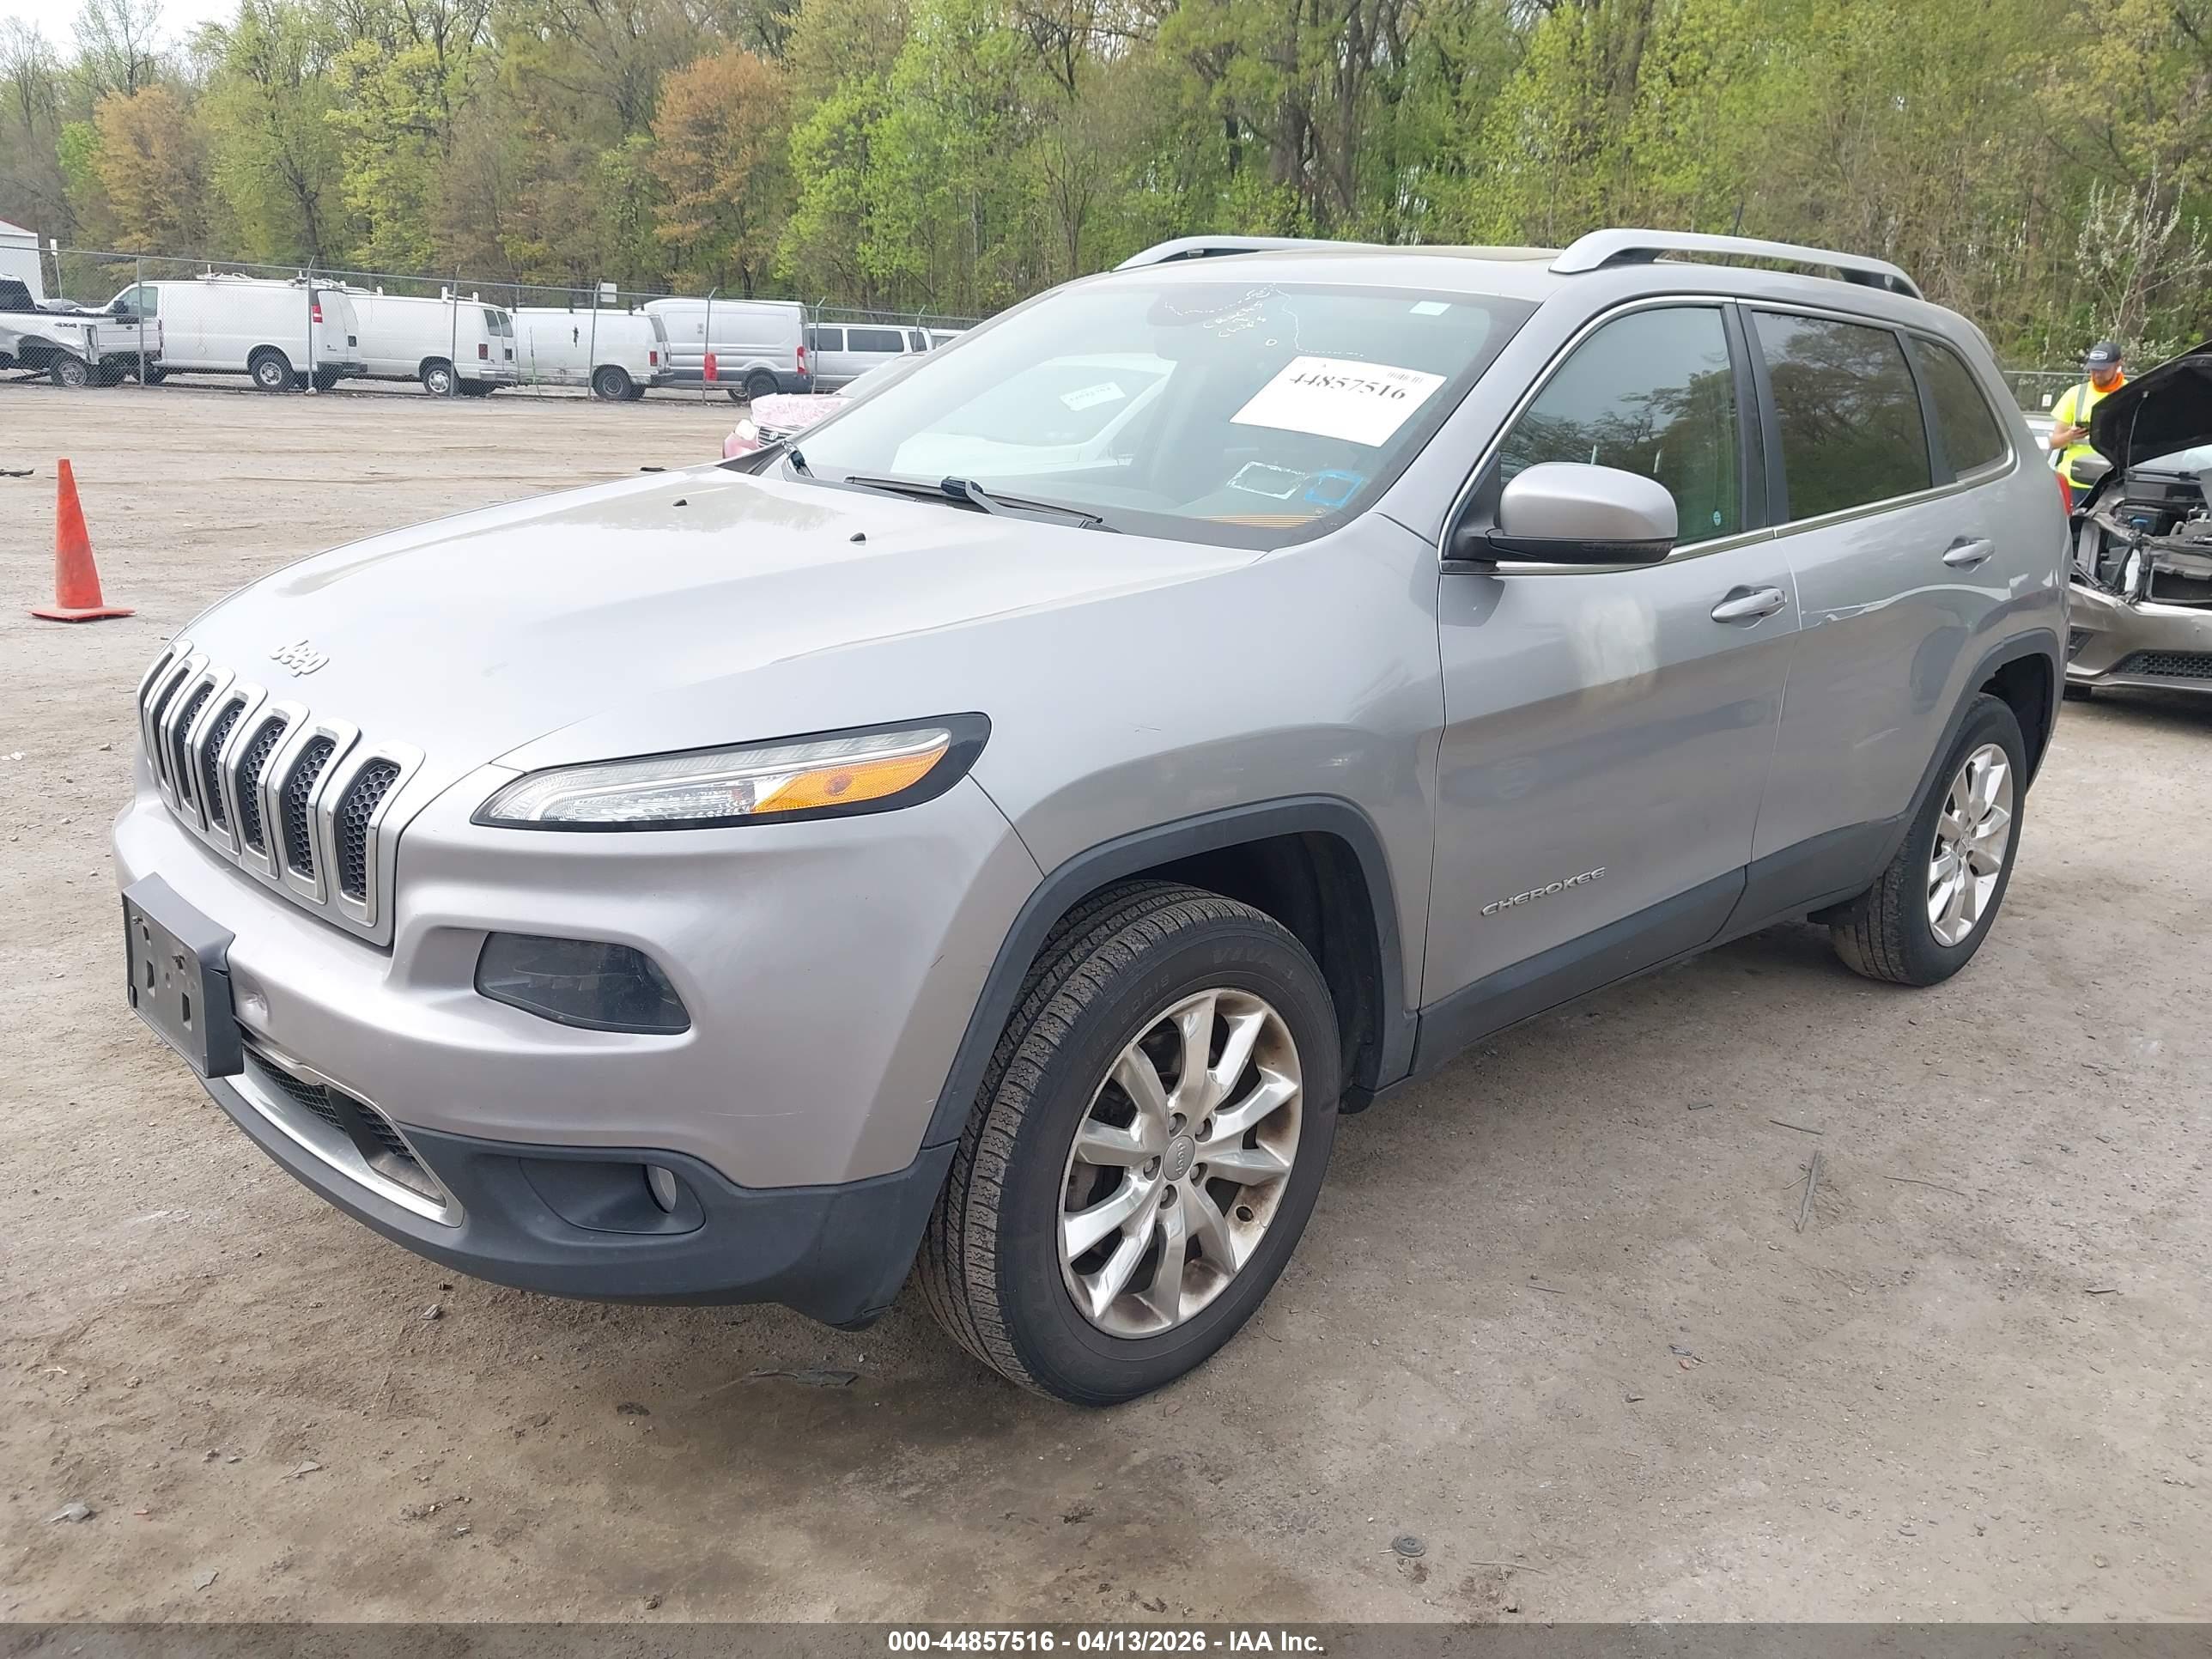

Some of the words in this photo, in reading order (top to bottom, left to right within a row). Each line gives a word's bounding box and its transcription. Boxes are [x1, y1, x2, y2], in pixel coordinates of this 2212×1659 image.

[1290, 373, 1407, 399] 44857516
[269, 639, 331, 678] Jeep
[1481, 866, 1607, 916] CHEROKEE
[1176, 1142, 1187, 1175] Jeep
